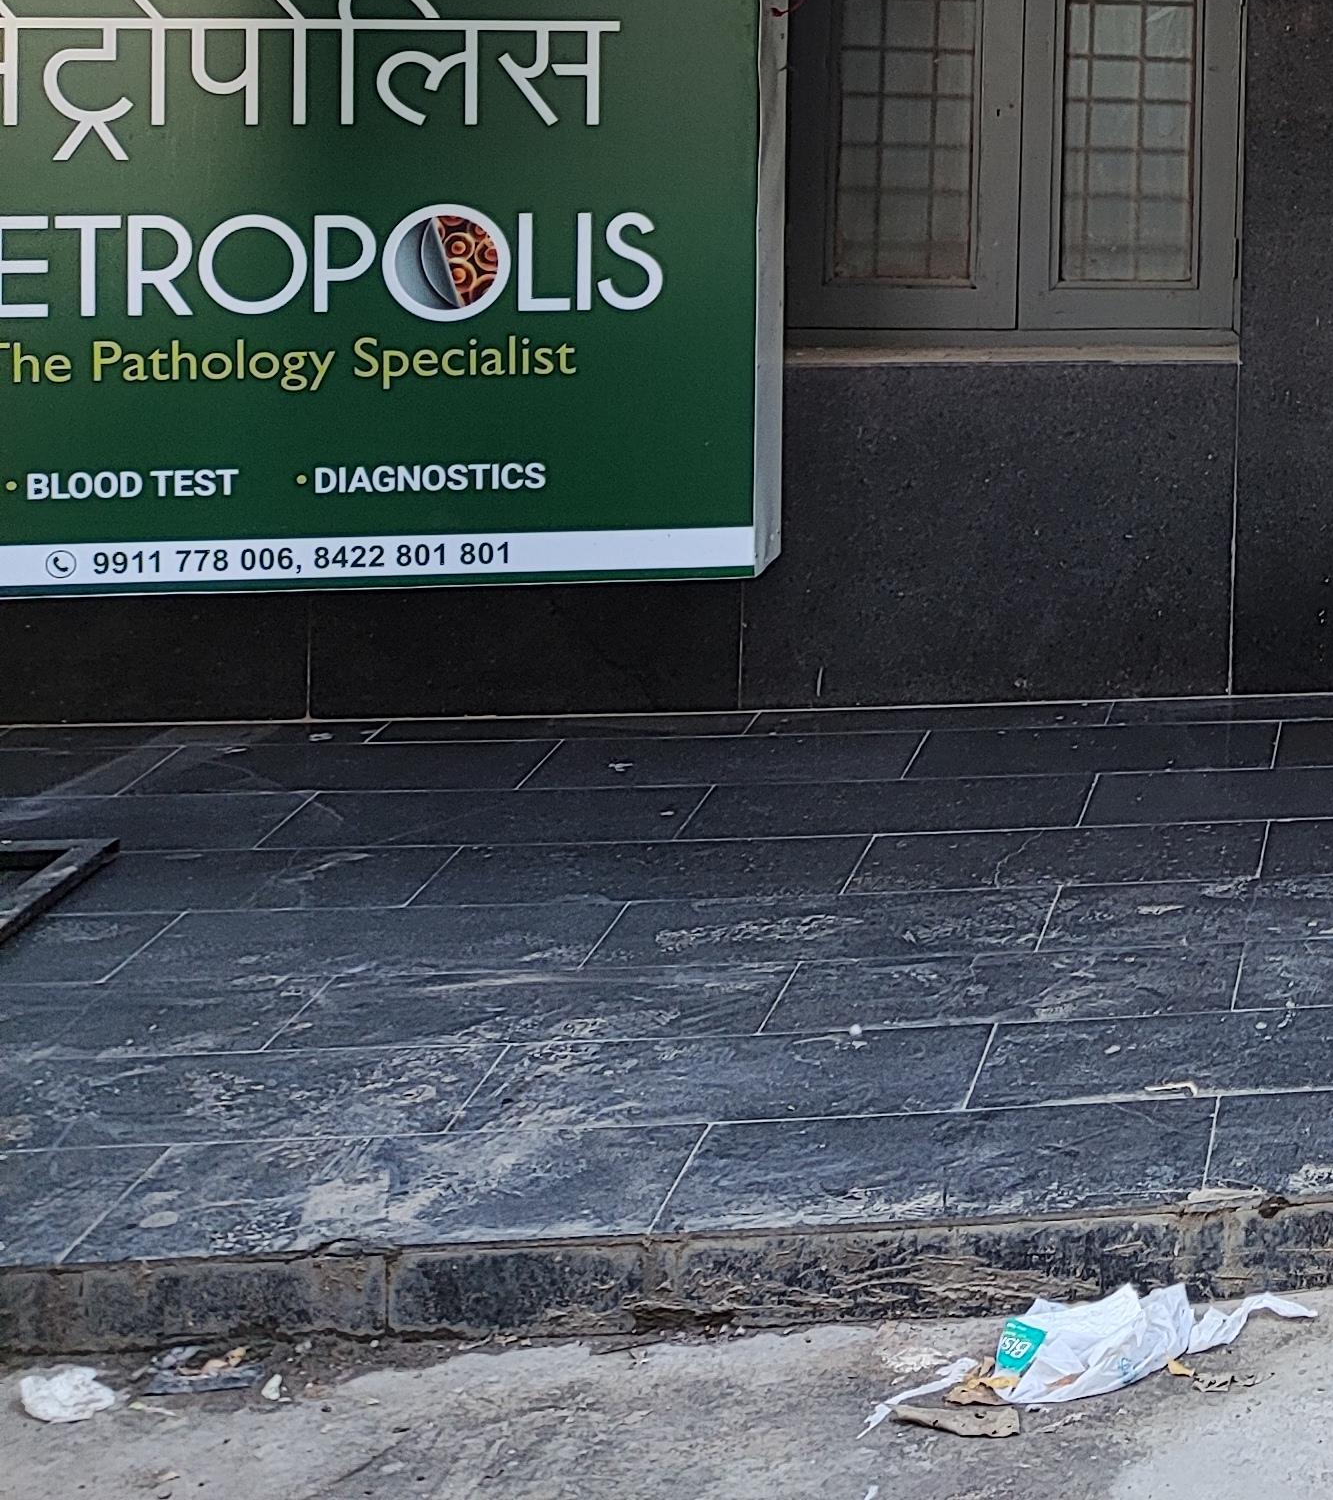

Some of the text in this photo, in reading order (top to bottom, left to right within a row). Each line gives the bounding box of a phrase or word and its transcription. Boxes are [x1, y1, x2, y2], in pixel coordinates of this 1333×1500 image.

[0, 335, 577, 391] he Pathology Specialist
[27, 462, 546, 500] BLOOD TEST DIAGNOSTICS
[92, 540, 512, 576] 9911 778 006, 8422 801 801
